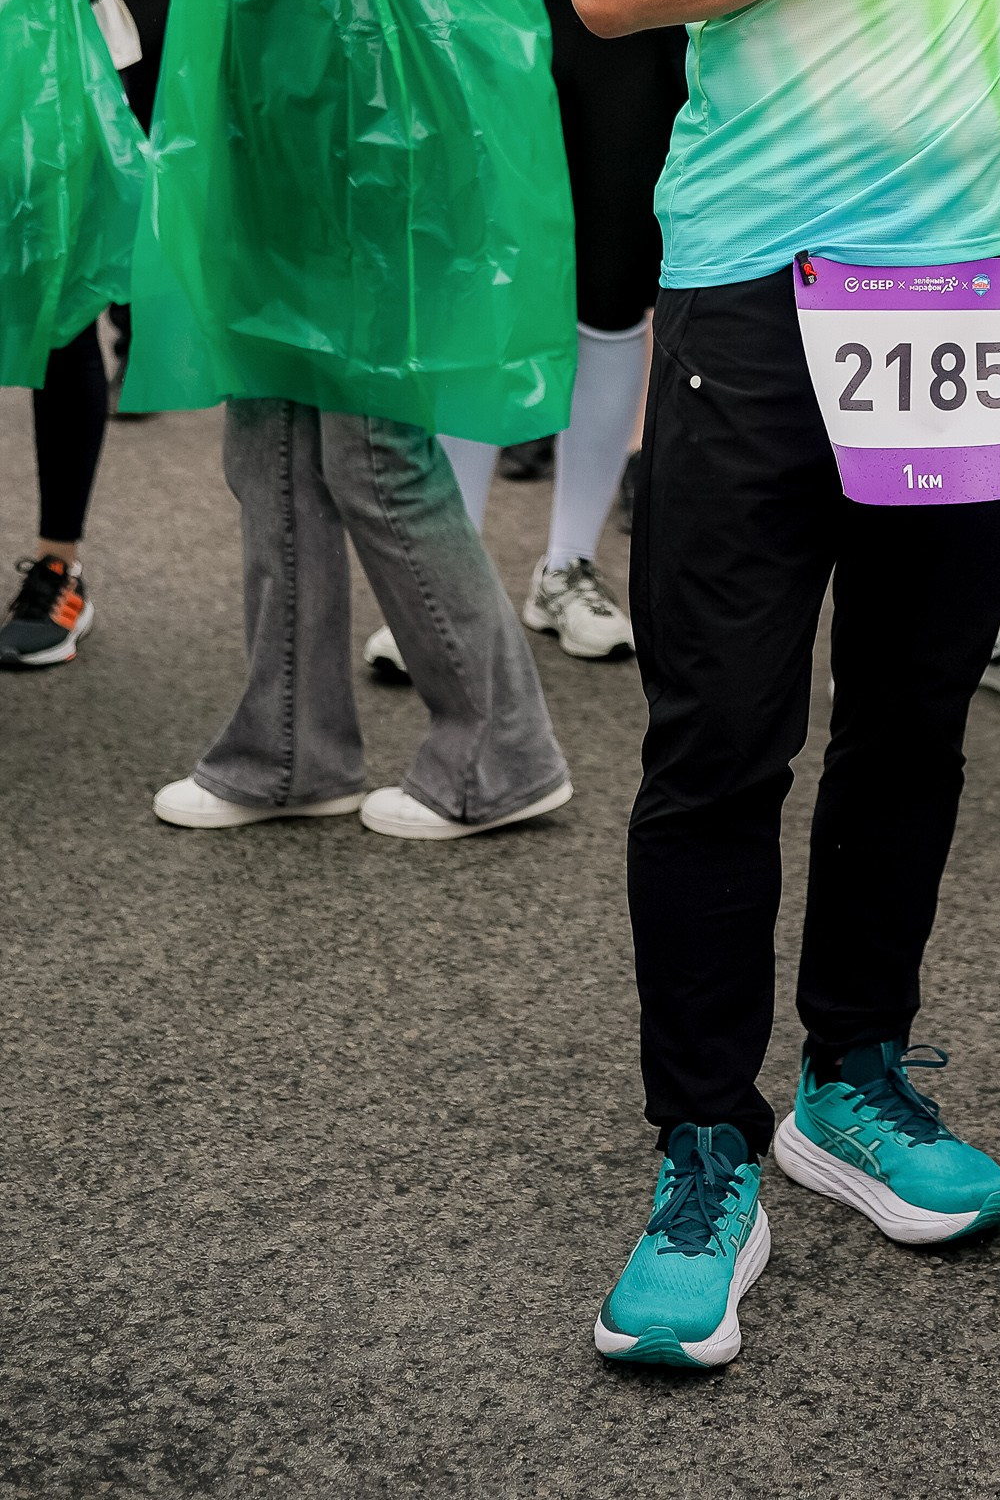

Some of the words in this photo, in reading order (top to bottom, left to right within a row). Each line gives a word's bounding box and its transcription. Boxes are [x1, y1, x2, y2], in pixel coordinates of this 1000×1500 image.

[861, 279, 894, 290] СБЕР
[913, 276, 945, 285] зелёный
[909, 284, 942, 293] марафон
